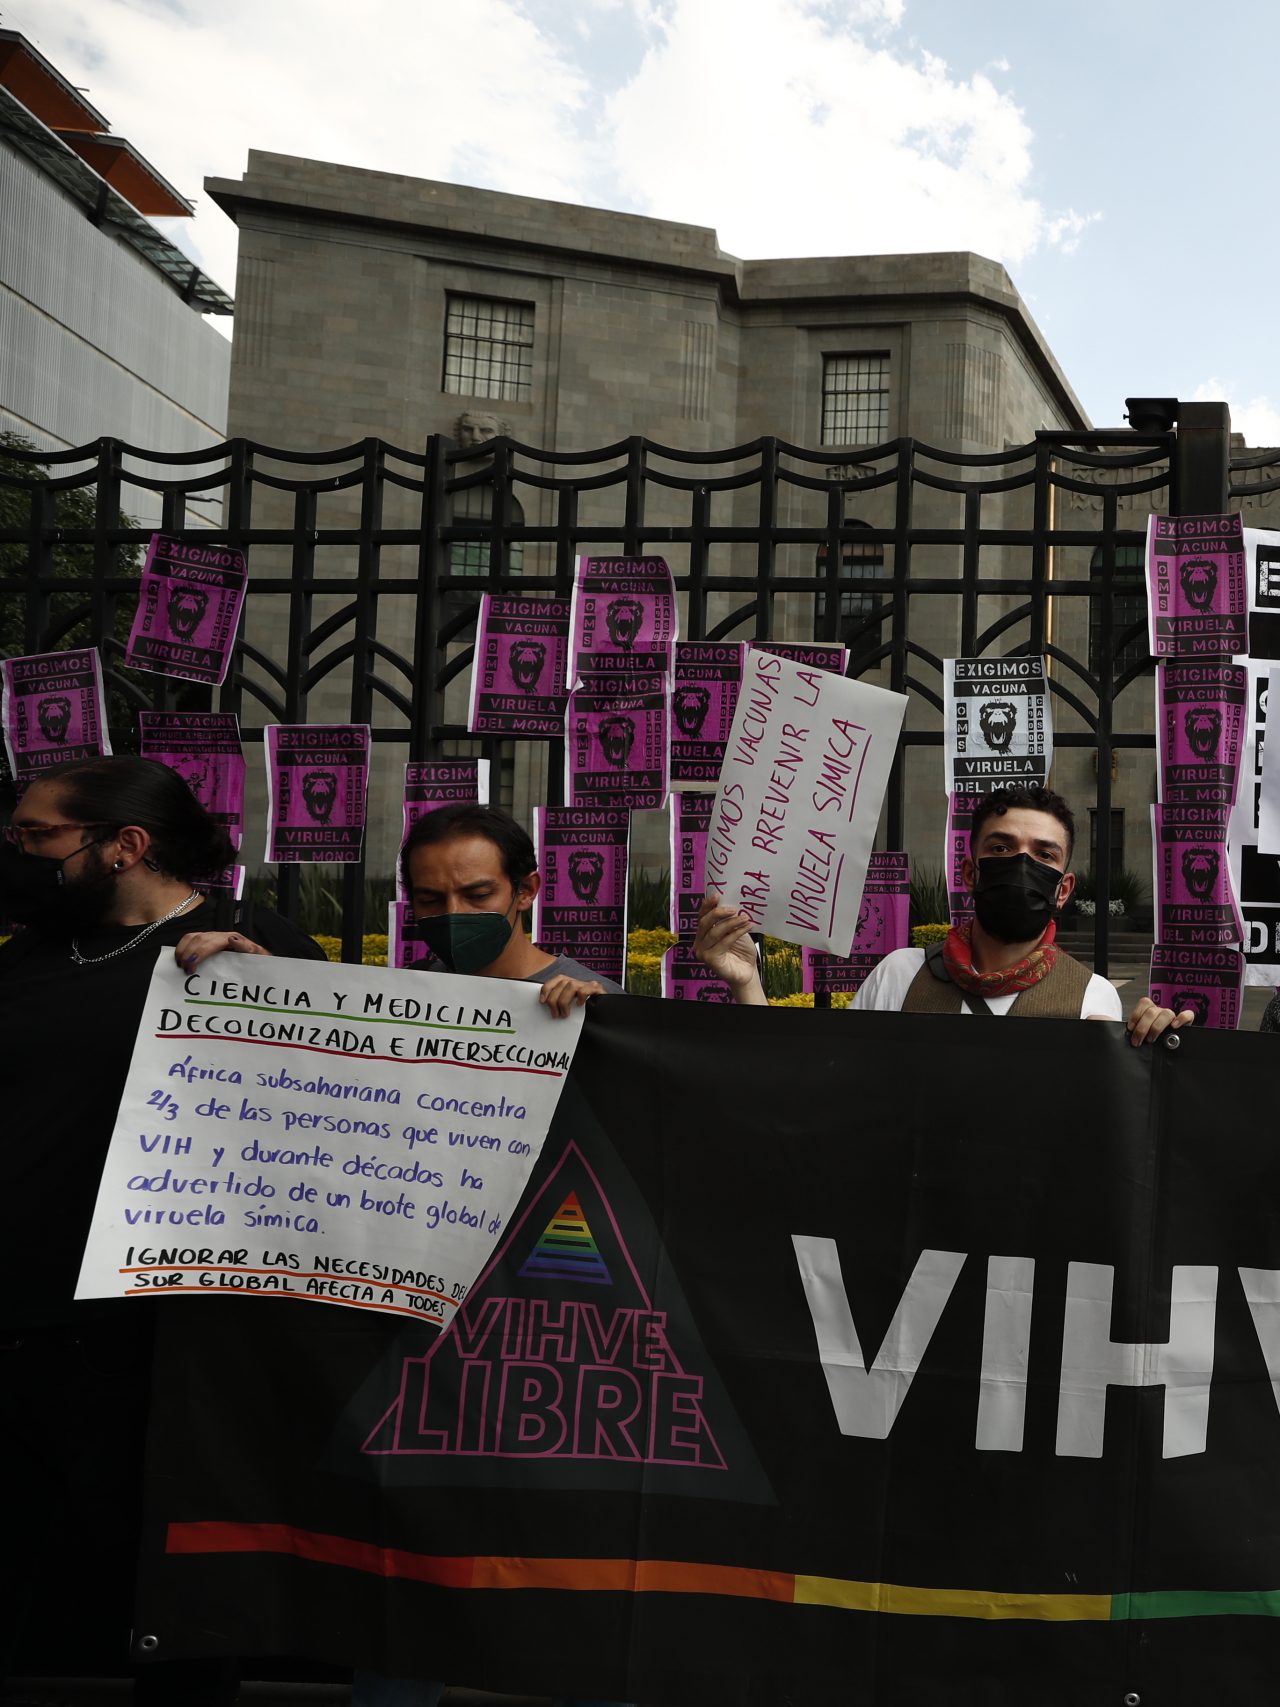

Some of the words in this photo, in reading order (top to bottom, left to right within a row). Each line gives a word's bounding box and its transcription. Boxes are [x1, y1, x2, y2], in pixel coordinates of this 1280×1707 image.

[1157, 519, 1240, 535] EXIGIMOS
[1172, 541, 1228, 552] VACUNA
[157, 540, 242, 568] EXIGIMOS
[169, 565, 225, 584] VACUNA
[588, 561, 666, 574] EXIGIMOS
[601, 581, 655, 592] VACUNA
[491, 602, 570, 616] EXIGIMOS
[505, 621, 558, 634] VACUNA
[1168, 620, 1235, 632] VIRUELA
[1158, 641, 1186, 653] DEL
[1193, 639, 1240, 651] MONO
[146, 643, 212, 667] VIRUELA
[14, 656, 90, 676] EXIGIMOS
[590, 657, 656, 669] VIRUELA
[956, 662, 1041, 676] EXIGIMOS
[1166, 669, 1244, 684] EXIGIMOS
[27, 678, 80, 691] VACUNA
[794, 671, 822, 707] LA
[972, 683, 1027, 694] VACUNA
[491, 698, 556, 712] VIRUELA
[733, 657, 781, 766] VACUNAS
[478, 718, 506, 729] DEL
[513, 719, 560, 731] MONO
[957, 706, 968, 750] OMS
[278, 733, 364, 745] EXIGIMOS
[27, 751, 89, 766] VIRUELA
[294, 754, 348, 764] VACUNA
[965, 760, 1033, 773] VIRUELA
[585, 775, 650, 787] VIRUELA
[955, 781, 984, 793] DEL
[575, 797, 603, 807] DEL
[609, 795, 656, 807] MONO
[547, 812, 628, 824] EXIGIMOS
[786, 829, 836, 932] VIRUELA
[813, 718, 866, 812] SIMICA
[285, 832, 350, 843] VIRUELA
[561, 833, 615, 842] VACUNA
[553, 911, 618, 922] VIRUELA
[543, 932, 570, 942] DEL
[578, 931, 623, 942] MONO
[1153, 950, 1237, 966] EXIGIMOS
[1167, 971, 1222, 984] VACUNA
[184, 974, 311, 1008] CIENCIA
[333, 992, 348, 1011] Y
[363, 993, 513, 1028] MEDICINA
[159, 1008, 376, 1054] DECOLONIZADA
[390, 1037, 404, 1056] E
[257, 1069, 401, 1104] subsahariana
[417, 1093, 526, 1120] concentra
[147, 1089, 179, 1121] 2/3
[196, 1096, 231, 1120] de
[239, 1098, 272, 1123] las
[285, 1112, 391, 1141] personas
[403, 1125, 438, 1151] que
[449, 1130, 502, 1152] viven
[140, 1134, 191, 1155] VIH
[213, 1149, 225, 1167] y
[241, 1140, 331, 1169] durante
[342, 1154, 443, 1190] décadas
[461, 1168, 483, 1190] ha
[126, 1170, 276, 1198] advertido
[288, 1182, 319, 1203] de
[327, 1190, 351, 1208] un
[361, 1189, 416, 1219] brote
[427, 1201, 486, 1231] global
[124, 1204, 225, 1227] viruela
[244, 1206, 325, 1235] símica.
[125, 1246, 248, 1267] IGNORAR
[262, 1252, 300, 1270] LAS
[314, 1256, 445, 1293] NECESIDADES
[135, 1272, 183, 1287] SUR
[199, 1272, 294, 1292] GLOBAL
[306, 1277, 373, 1302] AFECTA
[381, 1289, 394, 1303] A
[394, 1357, 703, 1463] LIBRE
